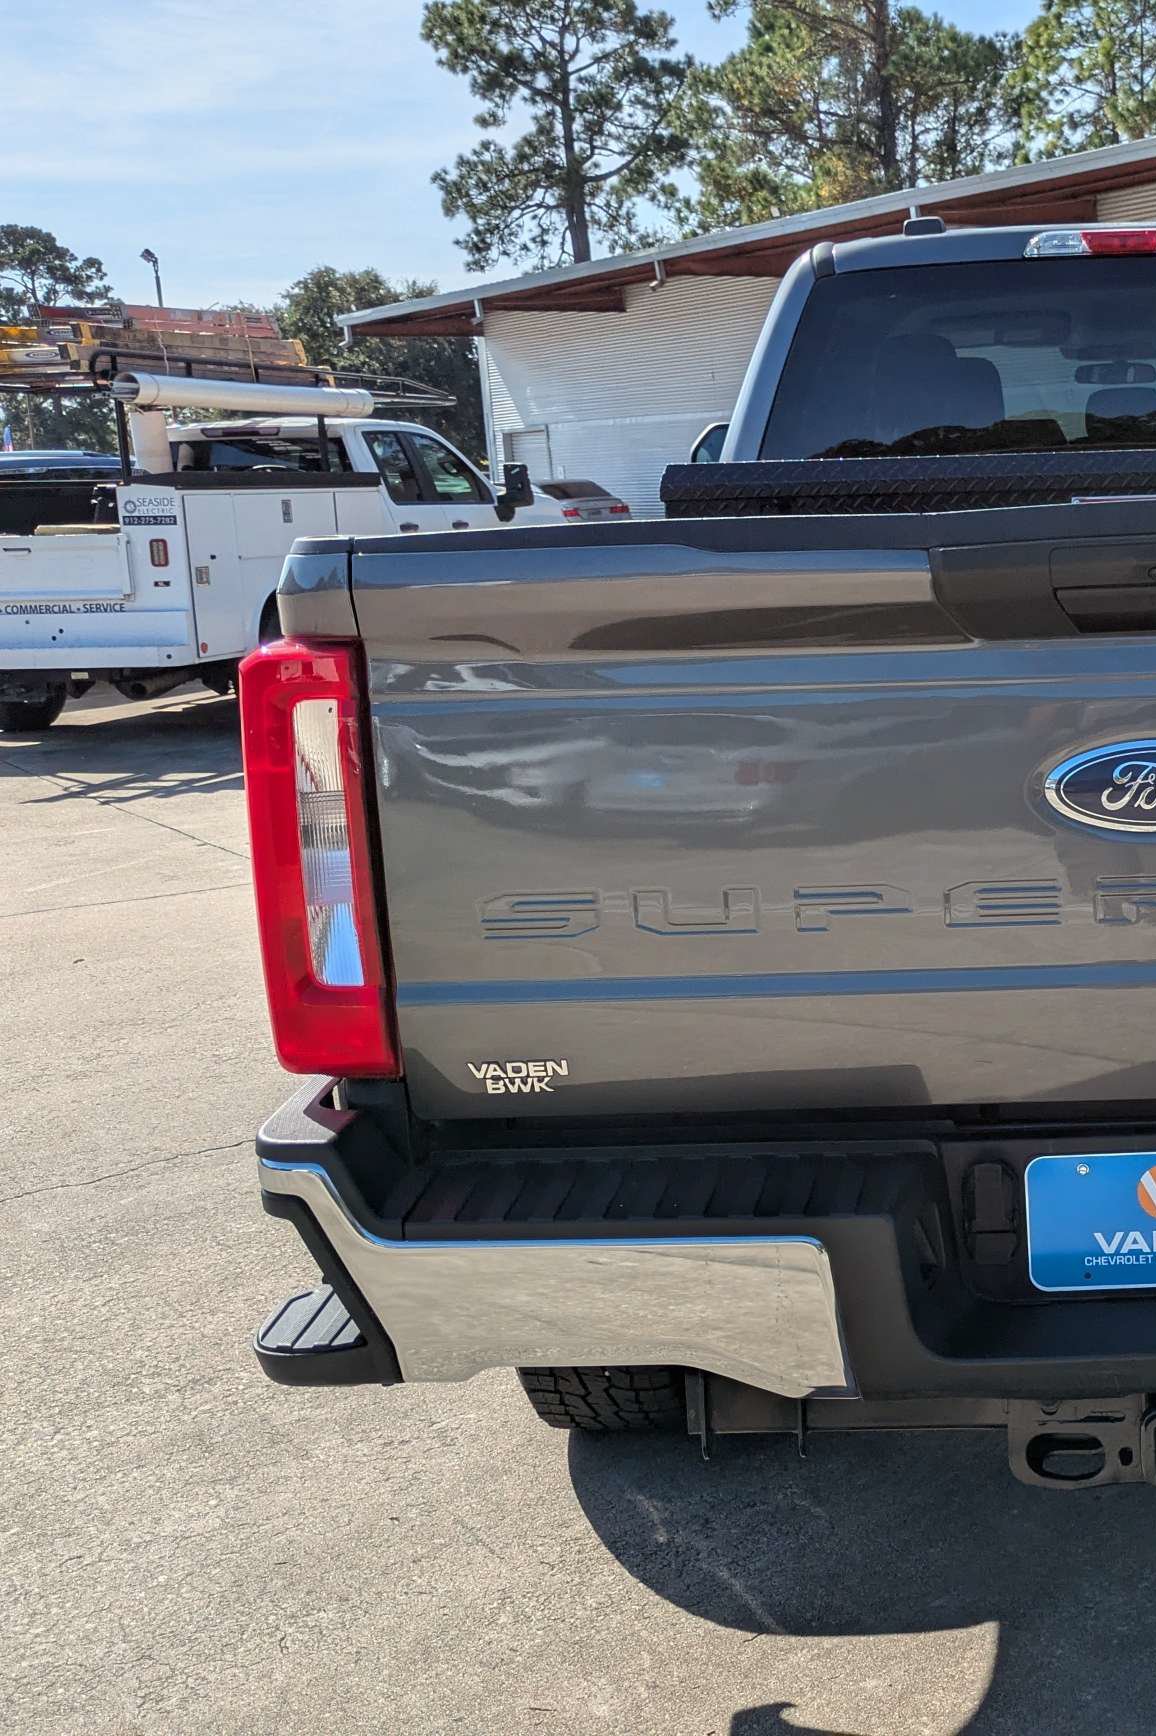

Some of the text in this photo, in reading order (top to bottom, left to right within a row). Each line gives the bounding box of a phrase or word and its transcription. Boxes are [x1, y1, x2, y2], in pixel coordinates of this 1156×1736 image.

[136, 497, 176, 507] SEASIDE
[5, 602, 126, 615] COMMERCIAL SERVICE
[467, 1060, 569, 1079] VADEN
[486, 1077, 555, 1094] BWK
[1084, 1254, 1154, 1266] CHEVROLET
